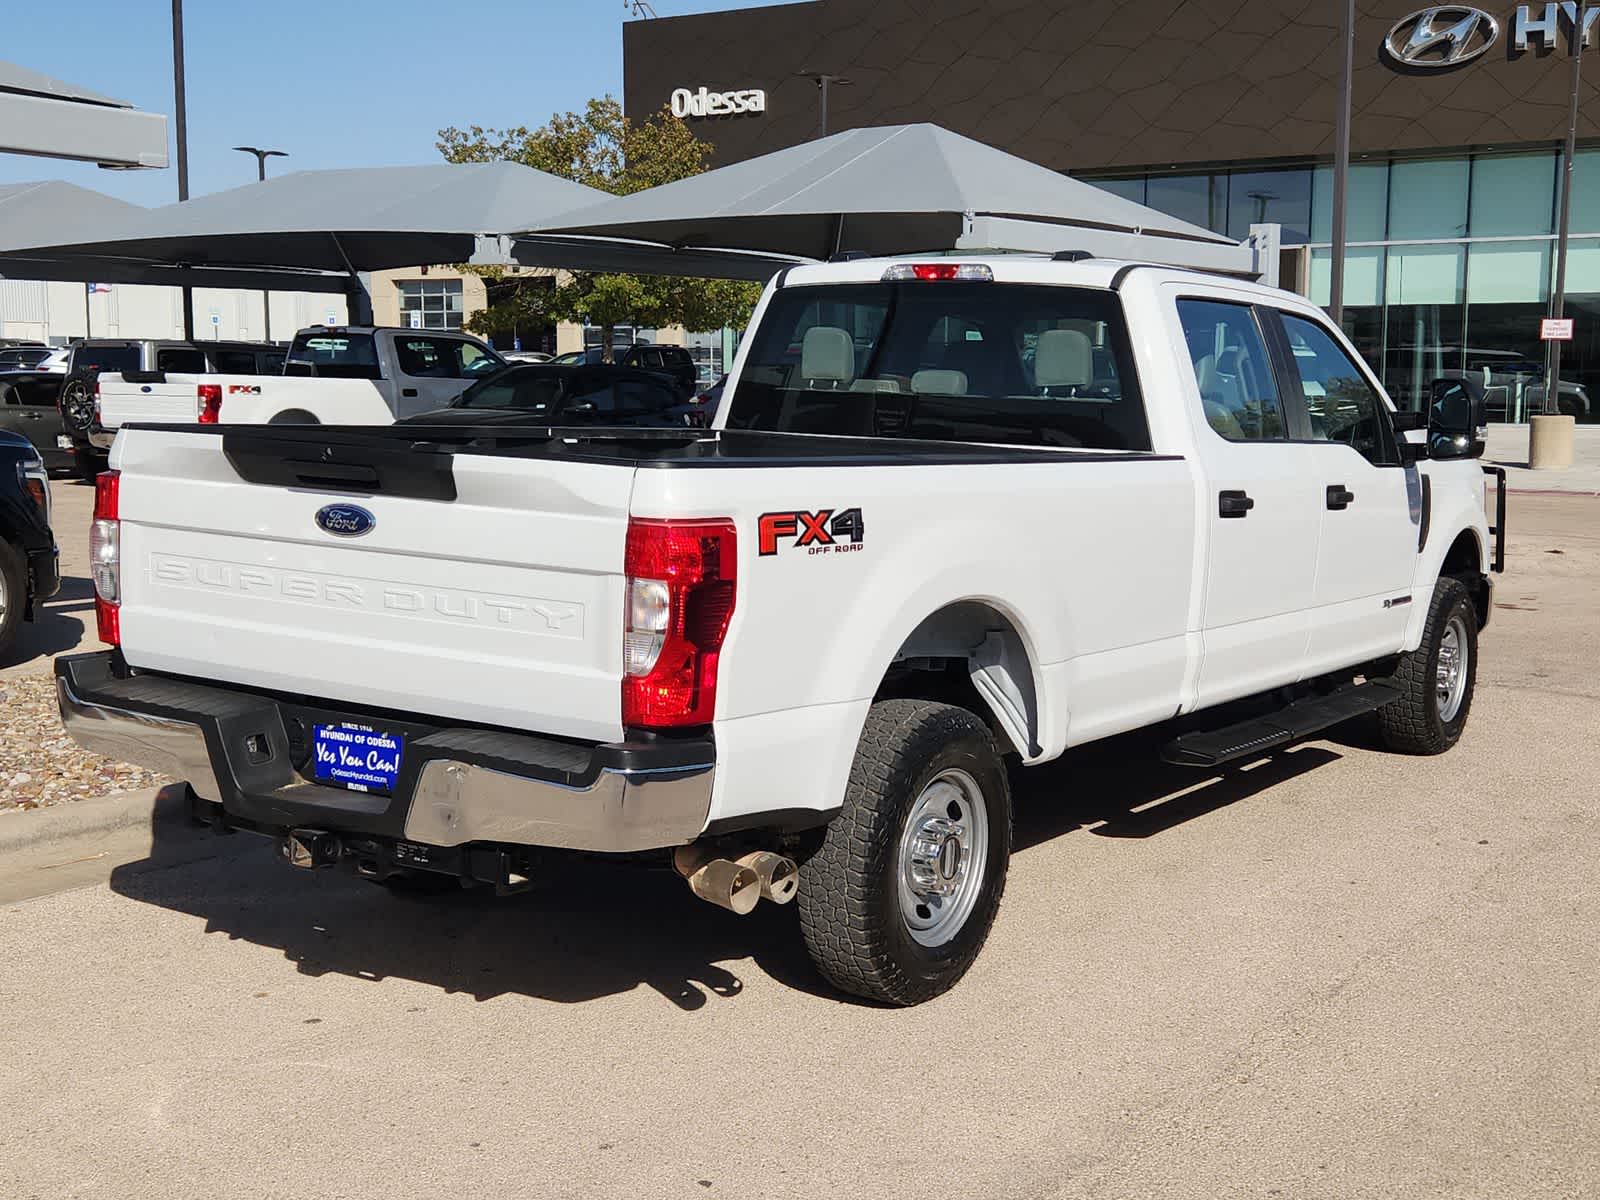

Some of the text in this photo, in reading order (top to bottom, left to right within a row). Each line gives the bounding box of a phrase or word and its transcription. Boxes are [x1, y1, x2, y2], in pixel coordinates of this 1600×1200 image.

[671, 87, 765, 118] Odessa
[326, 509, 360, 530] Ford
[758, 507, 864, 556] FX4
[808, 544, 864, 555] OFF ROAD
[153, 558, 577, 630] SUPER DUTY
[320, 729, 397, 749] HYUNDAI OF ODESSA
[316, 742, 400, 774] Yes You Can!
